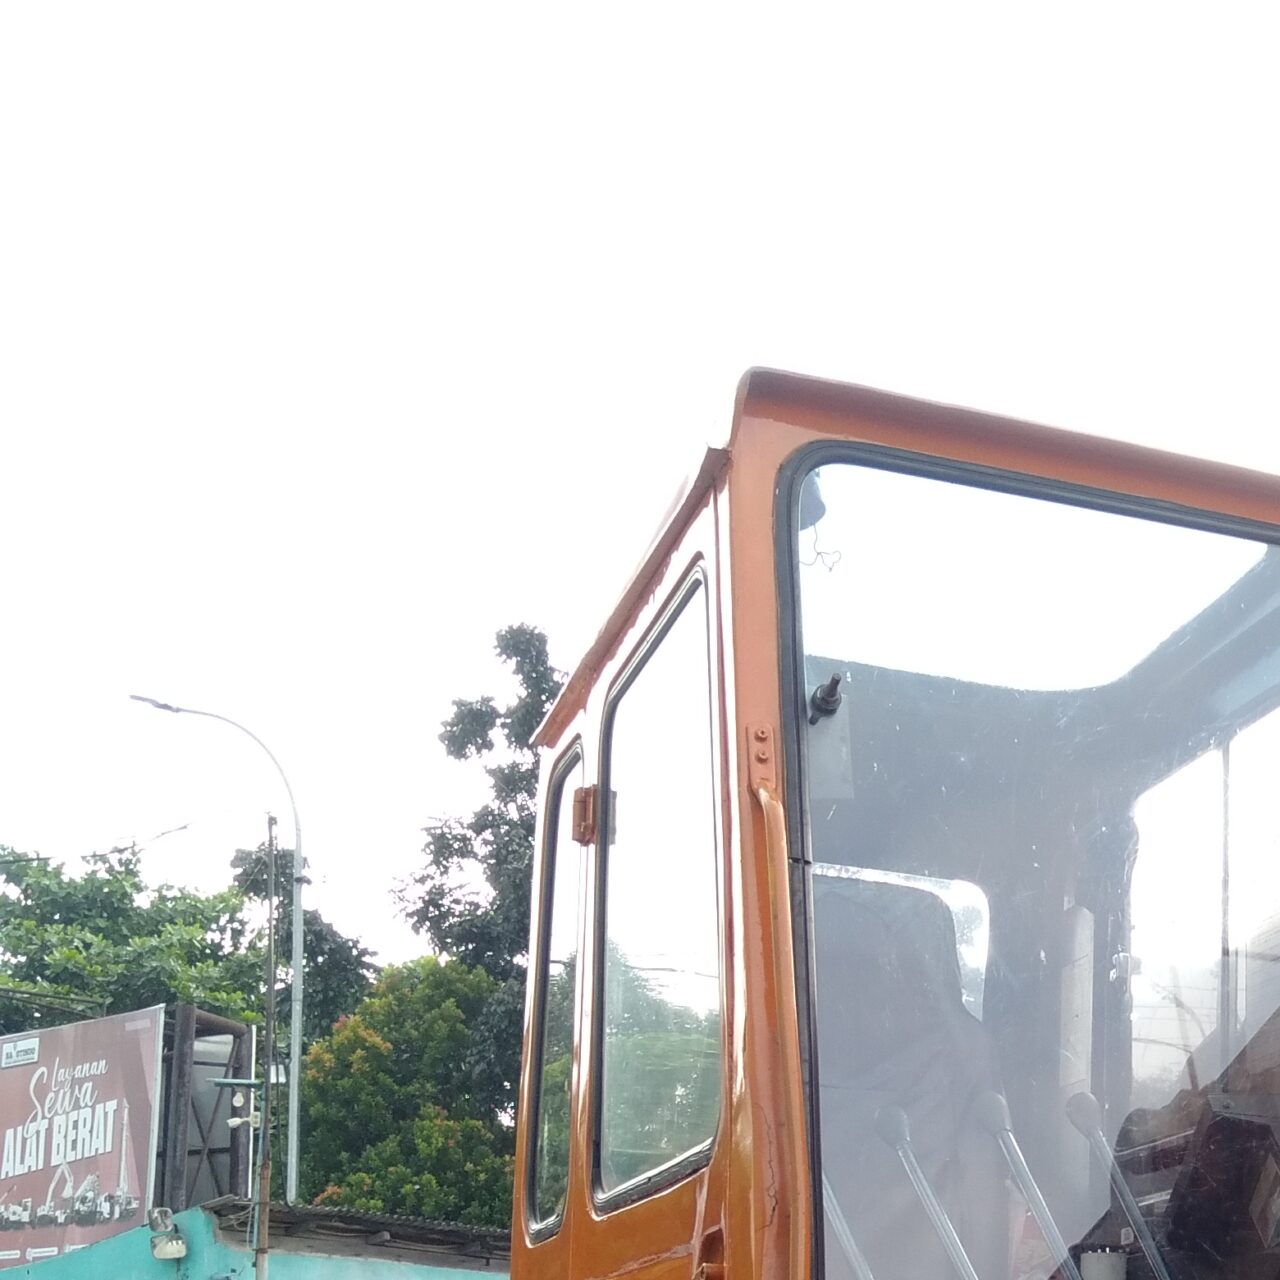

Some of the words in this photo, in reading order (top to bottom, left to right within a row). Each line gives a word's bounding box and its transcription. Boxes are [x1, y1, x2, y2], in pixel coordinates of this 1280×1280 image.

[23, 1066, 98, 1138] Sewa
[52, 1057, 109, 1091] Layanan
[0, 1118, 49, 1180] ALAT
[50, 1099, 118, 1167] BERAT
